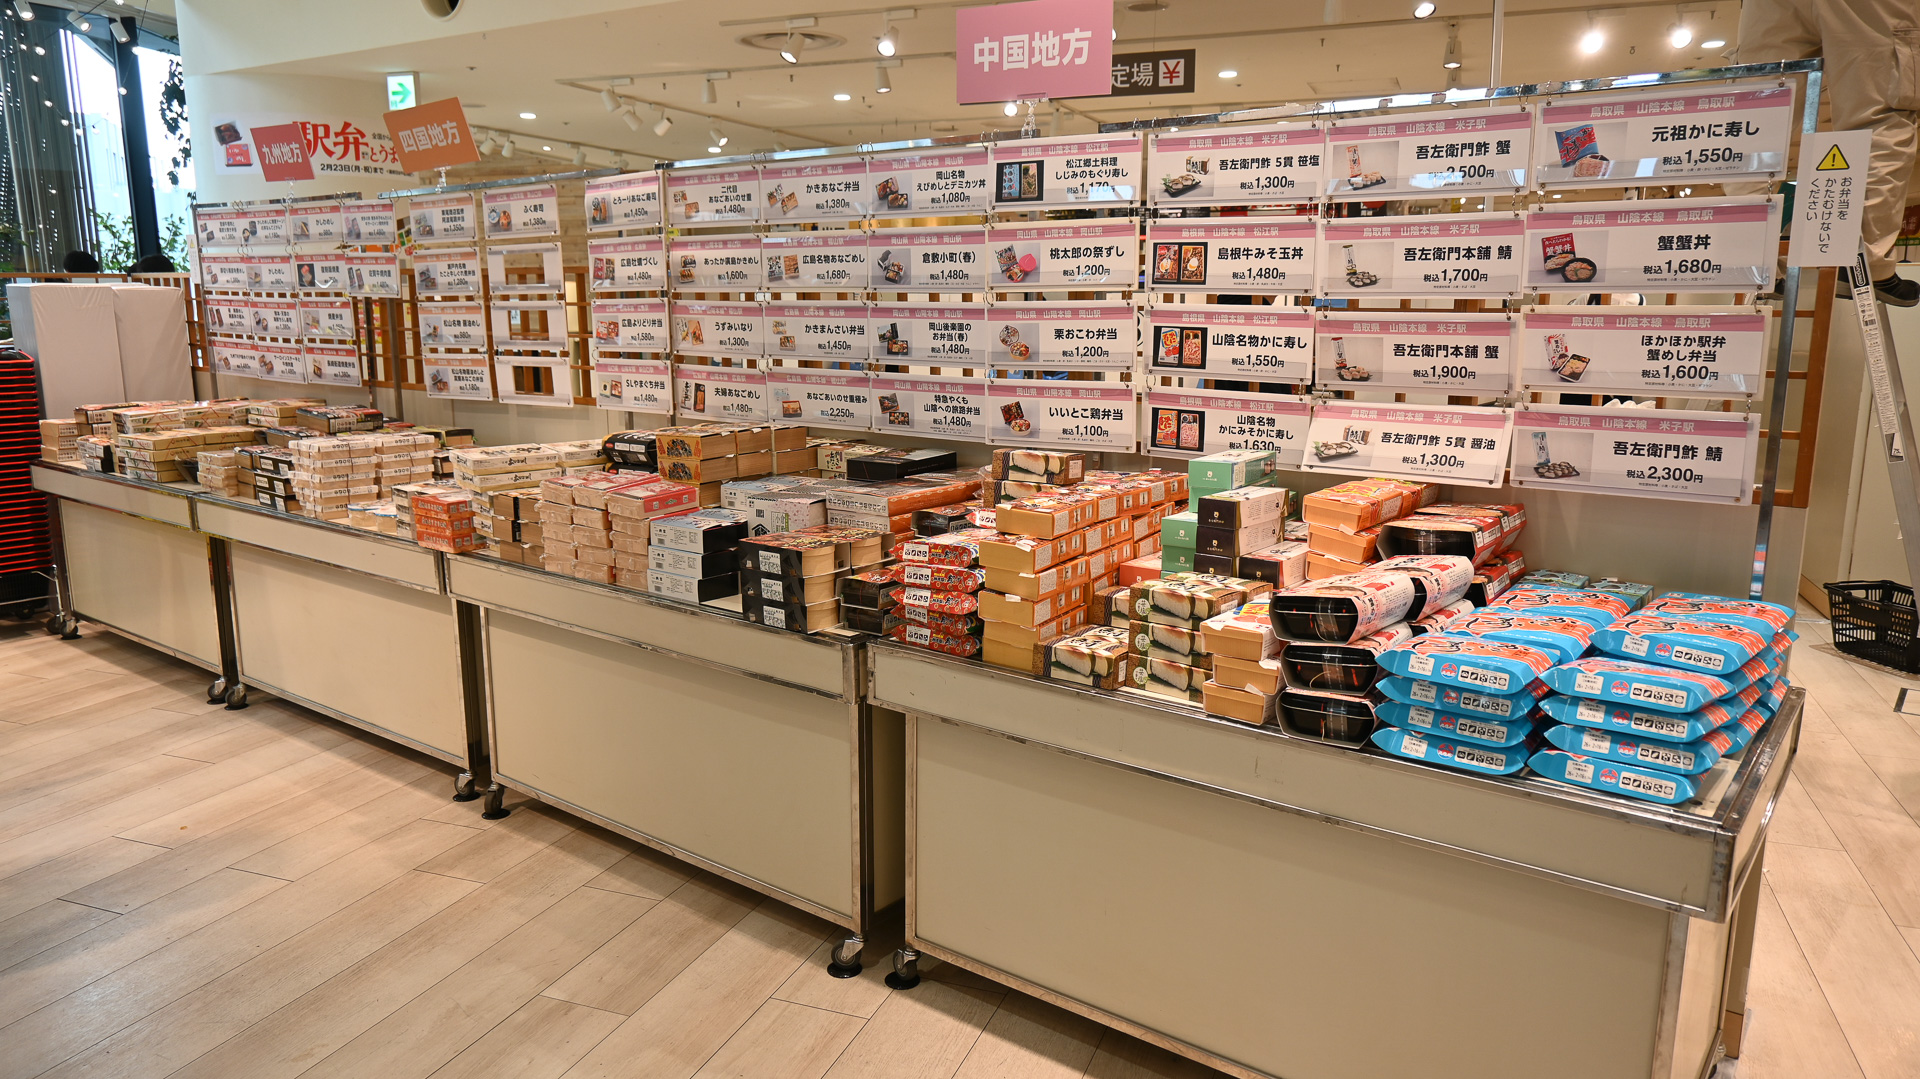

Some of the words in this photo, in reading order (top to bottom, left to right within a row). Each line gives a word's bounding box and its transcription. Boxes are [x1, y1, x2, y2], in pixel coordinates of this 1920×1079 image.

[974, 28, 1092, 72] 中国地方
[1591, 105, 1624, 118] 鳥取県
[1637, 100, 1684, 114] 山陰本線
[1698, 97, 1735, 109] 鳥取駅
[1368, 126, 1396, 136] 鳥取県
[1406, 122, 1445, 134] 山陰本線
[1456, 119, 1486, 130] 米子駅
[1652, 121, 1760, 142] 元祖かに寿し
[293, 121, 369, 161] 駅弁
[398, 120, 461, 153] 四国地方
[1189, 139, 1212, 148] 鳥取県
[1221, 136, 1253, 147] 山陰本線
[1262, 134, 1287, 144] 米子駅
[262, 142, 303, 164] 九州地方
[1416, 142, 1490, 159] 吾左衛門鮓
[1496, 140, 1510, 154] 蟹
[1066, 157, 1117, 168] 松江郷土料理
[1219, 158, 1271, 170] 吾左衛門鮓
[1276, 156, 1293, 168] 5貫
[1298, 155, 1319, 167] 笹塩
[1662, 147, 1743, 166] 税込1,550円
[936, 170, 965, 180] 岡山名物
[1055, 169, 1128, 180] しじみのもぐり寿し
[721, 185, 737, 193] 二代目
[806, 181, 859, 193] かきあなご弁当
[917, 179, 986, 191] えびめしとデミカツ丼
[1240, 176, 1294, 190] 税込1,300円
[709, 193, 751, 203] あなごあいのせ重
[931, 192, 970, 204] 税込1,080円
[1806, 178, 1819, 220] ください
[1837, 177, 1852, 220] お弁当を
[716, 204, 745, 214] 税込1,480円
[816, 199, 850, 210] 税込1,380円
[1572, 215, 1605, 225] 鳥取県
[1618, 211, 1664, 223] 山陰本線
[1677, 210, 1713, 221] 鳥取駅
[1818, 178, 1837, 254] かたむけないで
[1182, 228, 1205, 237] 島根県
[1213, 228, 1245, 236] 山陰本線
[1254, 227, 1278, 236] 松江駅
[1363, 227, 1391, 236] 鳥取県
[1401, 225, 1439, 235] 山陰本線
[1450, 224, 1480, 234] 米子駅
[1657, 235, 1711, 251] 蟹蟹丼
[922, 251, 976, 263] 倉敷小町(春)
[1050, 246, 1124, 259] 桃太郎の祭ずし
[1218, 247, 1303, 260] 島根牛みそ玉丼
[1404, 245, 1491, 261] 吾左衛門本舗
[1497, 245, 1512, 260] 鯖
[803, 254, 865, 264] 広島名物あなごめし
[1063, 265, 1110, 277] 税込1,200円
[1643, 259, 1722, 275] 税込1,680円
[817, 270, 850, 281] 税込1,680円
[930, 269, 969, 281] 税込1,480円
[1232, 268, 1285, 281] 税込1,480円
[1424, 269, 1488, 284] 税込1,700円
[622, 319, 662, 327] 広島よりどり弁当
[1182, 313, 1205, 322] 島根県
[1213, 314, 1244, 323] 山陰本線
[1253, 315, 1278, 324] 松江駅
[1571, 317, 1604, 327] 鳥取県
[1616, 318, 1662, 327] 山陰本線
[1675, 318, 1711, 328] 鳥取駅
[715, 322, 752, 331] うずみいなり
[805, 324, 864, 335] かきまんさい弁当
[929, 323, 971, 331] 岡山後楽園の
[1353, 323, 1380, 332] 鳥取県
[1390, 324, 1427, 333] 山陰本線
[1437, 324, 1467, 333] 米子駅
[933, 333, 968, 342] お弁当(春)
[1054, 328, 1117, 339] 栗おこわ弁当
[720, 337, 749, 347] 税込1,300円
[818, 341, 851, 351] 税込1,450円
[1213, 334, 1307, 348] 山陰名物かに寿し
[1641, 335, 1726, 348] ほかほか駅弁
[931, 344, 969, 355] 税込1,480円
[1062, 347, 1109, 358] 税込1,200円
[1393, 344, 1478, 358] 吾左衛門本舗
[1485, 345, 1499, 359] 蟹
[1232, 355, 1284, 368] 税込1,550円
[1647, 350, 1717, 362] 蟹めし弁当
[1413, 366, 1475, 380] 税込1,900円
[1641, 365, 1718, 382] 税込1,600円
[626, 380, 665, 389] SLやまぐち弁当
[715, 387, 760, 399] 夫婦あなごめし
[934, 395, 968, 404] 特急やくも
[821, 408, 854, 418] 税込2,250円
[924, 404, 980, 415] 山陰への旅路弁当
[1049, 407, 1123, 420] いいとこ鶏弁当
[933, 416, 971, 427] 税込1,480円
[1237, 415, 1275, 427] 山陰名物
[1351, 410, 1377, 419] 鳥取県
[1387, 412, 1424, 421] 山陰本線
[1433, 414, 1462, 423] 米子駅
[1558, 417, 1590, 427] 鳥取県
[1603, 419, 1647, 430] 山陰本線
[1659, 421, 1694, 432] 米子駅
[1062, 426, 1109, 437] 税込1,100円
[1219, 425, 1293, 439] かにみそかに寿し
[1381, 433, 1440, 446] 吾左衛門鮓
[1445, 437, 1465, 448] 5貫
[1471, 438, 1496, 450] 醤油
[1613, 442, 1698, 460] 吾左衛門鮓
[1705, 444, 1723, 462] 鯖
[1402, 453, 1464, 468] 税込1,300円
[1626, 466, 1703, 483] 税込2,300円
